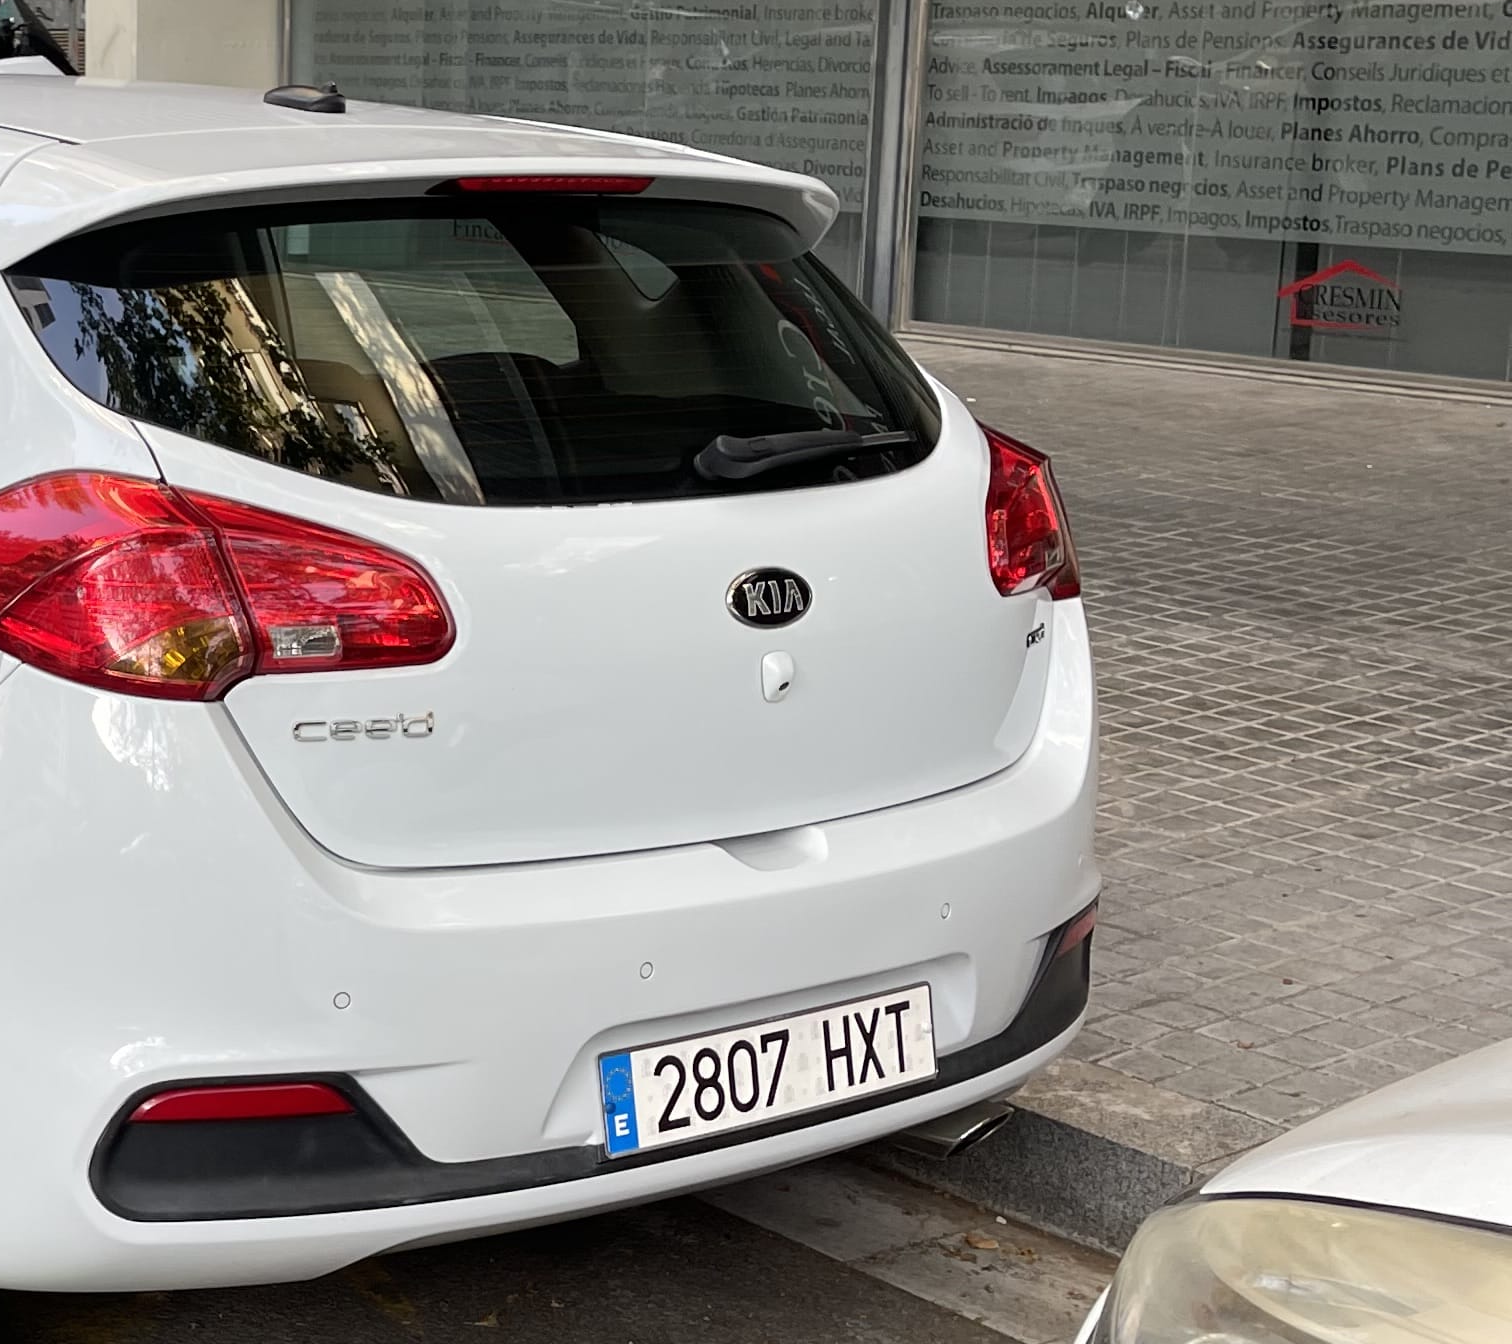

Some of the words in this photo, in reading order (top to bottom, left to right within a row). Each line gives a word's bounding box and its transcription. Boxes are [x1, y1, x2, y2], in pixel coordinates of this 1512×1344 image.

[1003, 3, 1081, 25] negocios,
[1221, 2, 1255, 19] and
[1261, 1, 1343, 24] Property
[1350, 0, 1495, 24] Management,
[598, 29, 614, 44] de
[785, 31, 821, 51] Legal
[824, 31, 852, 47] and
[1126, 30, 1170, 49] Plans
[1175, 30, 1197, 49] de
[1292, 30, 1436, 55] Assegurances
[1441, 30, 1467, 51] de
[817, 56, 871, 73] Divorcio
[982, 57, 1101, 78] Assessorament
[1104, 58, 1148, 82] Legal
[1311, 61, 1385, 82] Conseils
[1389, 61, 1486, 86] Juridiques
[1491, 64, 1512, 83] et
[927, 84, 943, 100] To
[946, 84, 969, 101] sell
[981, 85, 996, 102] To
[1294, 92, 1386, 115] Impostos,
[925, 111, 1033, 131] Administració
[1037, 112, 1056, 132] de
[1228, 120, 1276, 142] louer,
[1281, 121, 1343, 143] Planes
[1348, 123, 1424, 147] Ahorro,
[923, 137, 963, 155] Asset
[1214, 150, 1306, 173] Insurance
[1311, 153, 1379, 176] broker,
[1386, 156, 1444, 178] Plans
[1451, 157, 1479, 179] de
[921, 164, 1031, 188] Responsabilitat
[1236, 180, 1283, 201] Asset
[1287, 182, 1323, 202] and
[1328, 185, 1409, 211] Property
[920, 190, 1006, 213] Desahucios,
[1090, 201, 1120, 222] IVA,
[1123, 203, 1164, 224] IRPF,
[1168, 207, 1241, 230] Impagos,
[1245, 210, 1334, 235] Impostos,
[1336, 215, 1413, 240] Traspaso
[1417, 220, 1507, 247] negocios,
[1299, 283, 1403, 312] CRESMIN
[742, 578, 804, 617] KIA
[654, 1028, 790, 1133] 2807
[822, 1000, 910, 1092] HXT
[614, 1113, 631, 1138] E
